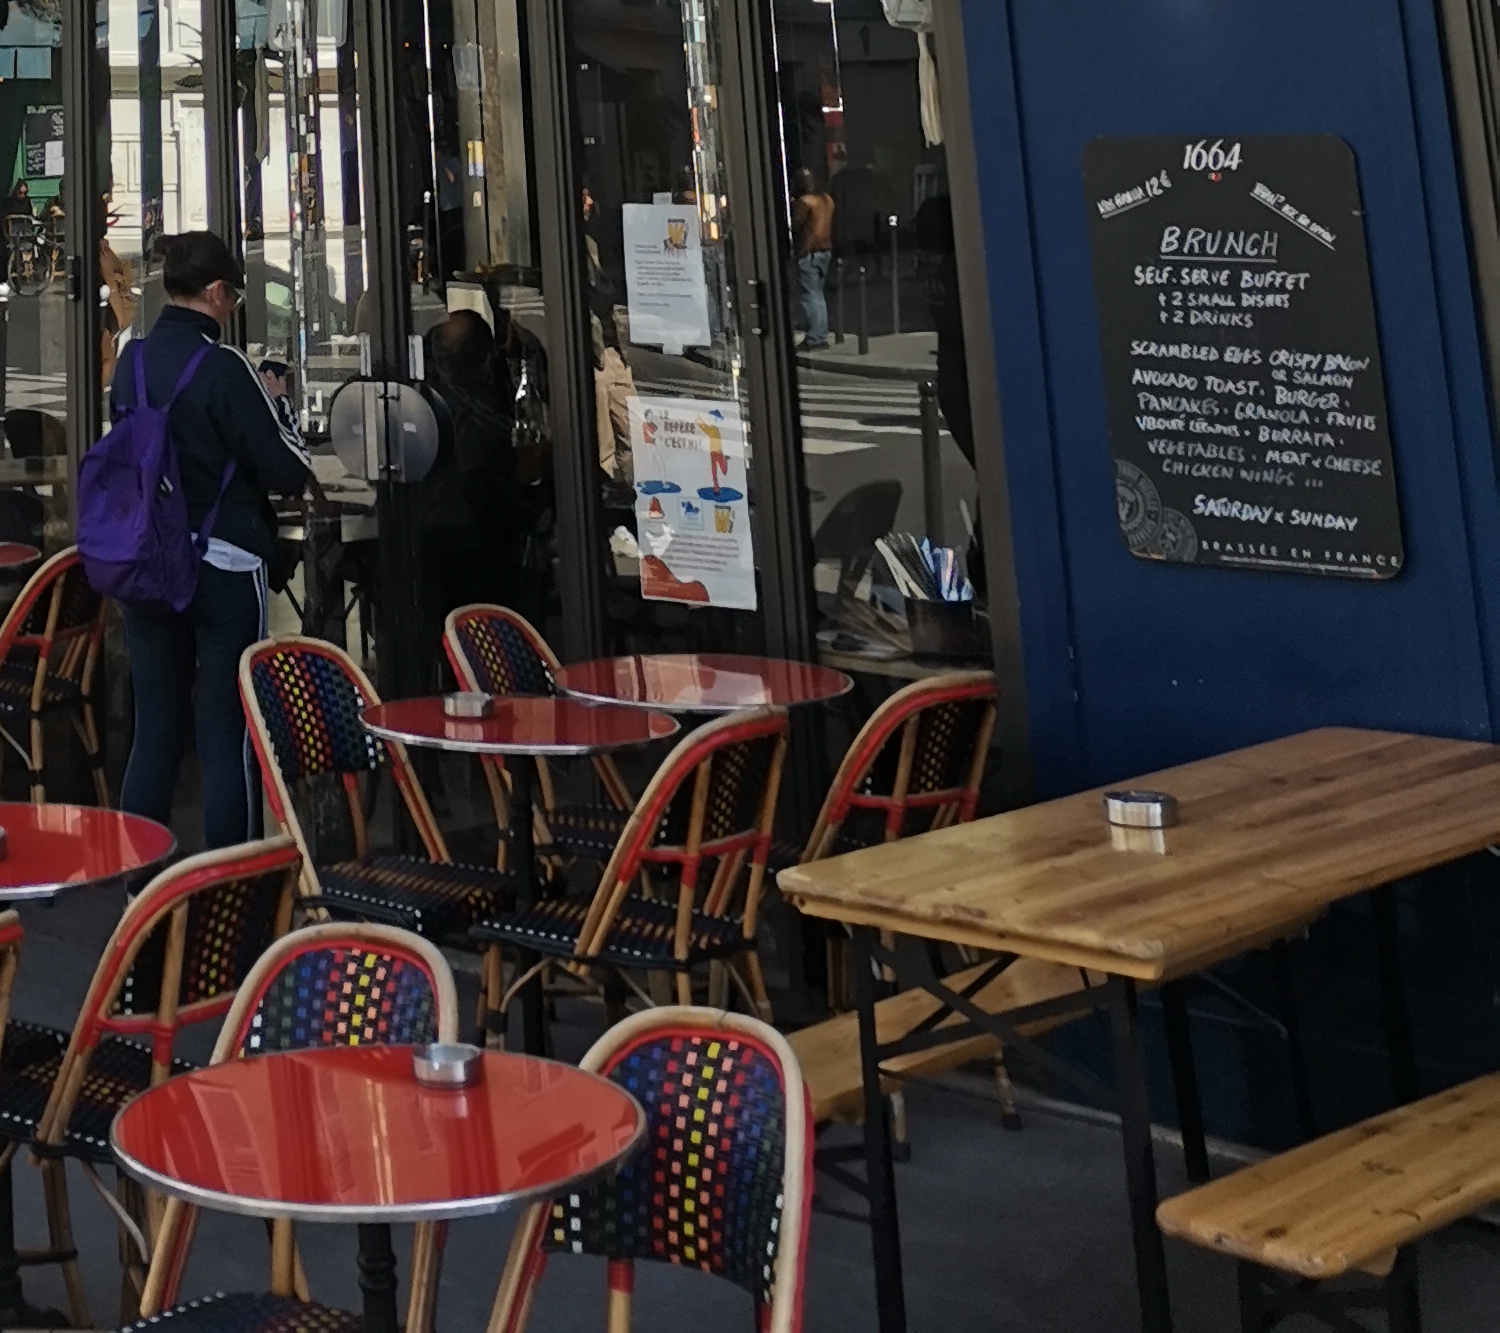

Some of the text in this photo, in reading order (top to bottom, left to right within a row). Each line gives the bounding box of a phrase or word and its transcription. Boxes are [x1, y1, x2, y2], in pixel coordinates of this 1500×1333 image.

[1183, 138, 1243, 171] 1664
[1159, 225, 1279, 257] BRUNCH
[1240, 270, 1311, 290] BUFFET
[1171, 292, 1183, 306] 2
[1187, 293, 1236, 307] SMALL
[1172, 310, 1185, 324] 2
[1130, 339, 1219, 361] SCRAMBLED
[1132, 368, 1198, 391] AVOCADO
[1274, 385, 1340, 410] BURGER
[1292, 370, 1354, 389] SALMON
[1136, 392, 1220, 416] PANCAKES
[1234, 402, 1310, 425] GRANOLA
[1258, 425, 1336, 448] BURRATA
[1147, 438, 1246, 463] VEGETABLES
[1264, 449, 1312, 466] MEAT
[1324, 454, 1383, 477] CHEESE
[1161, 459, 1235, 480] CHICKEN
[1240, 466, 1296, 487] WINGS
[1192, 494, 1275, 524] SATURDAY
[1289, 508, 1359, 532] SUNDAY
[1290, 546, 1312, 559] EN
[1324, 549, 1401, 568] FRANCE
